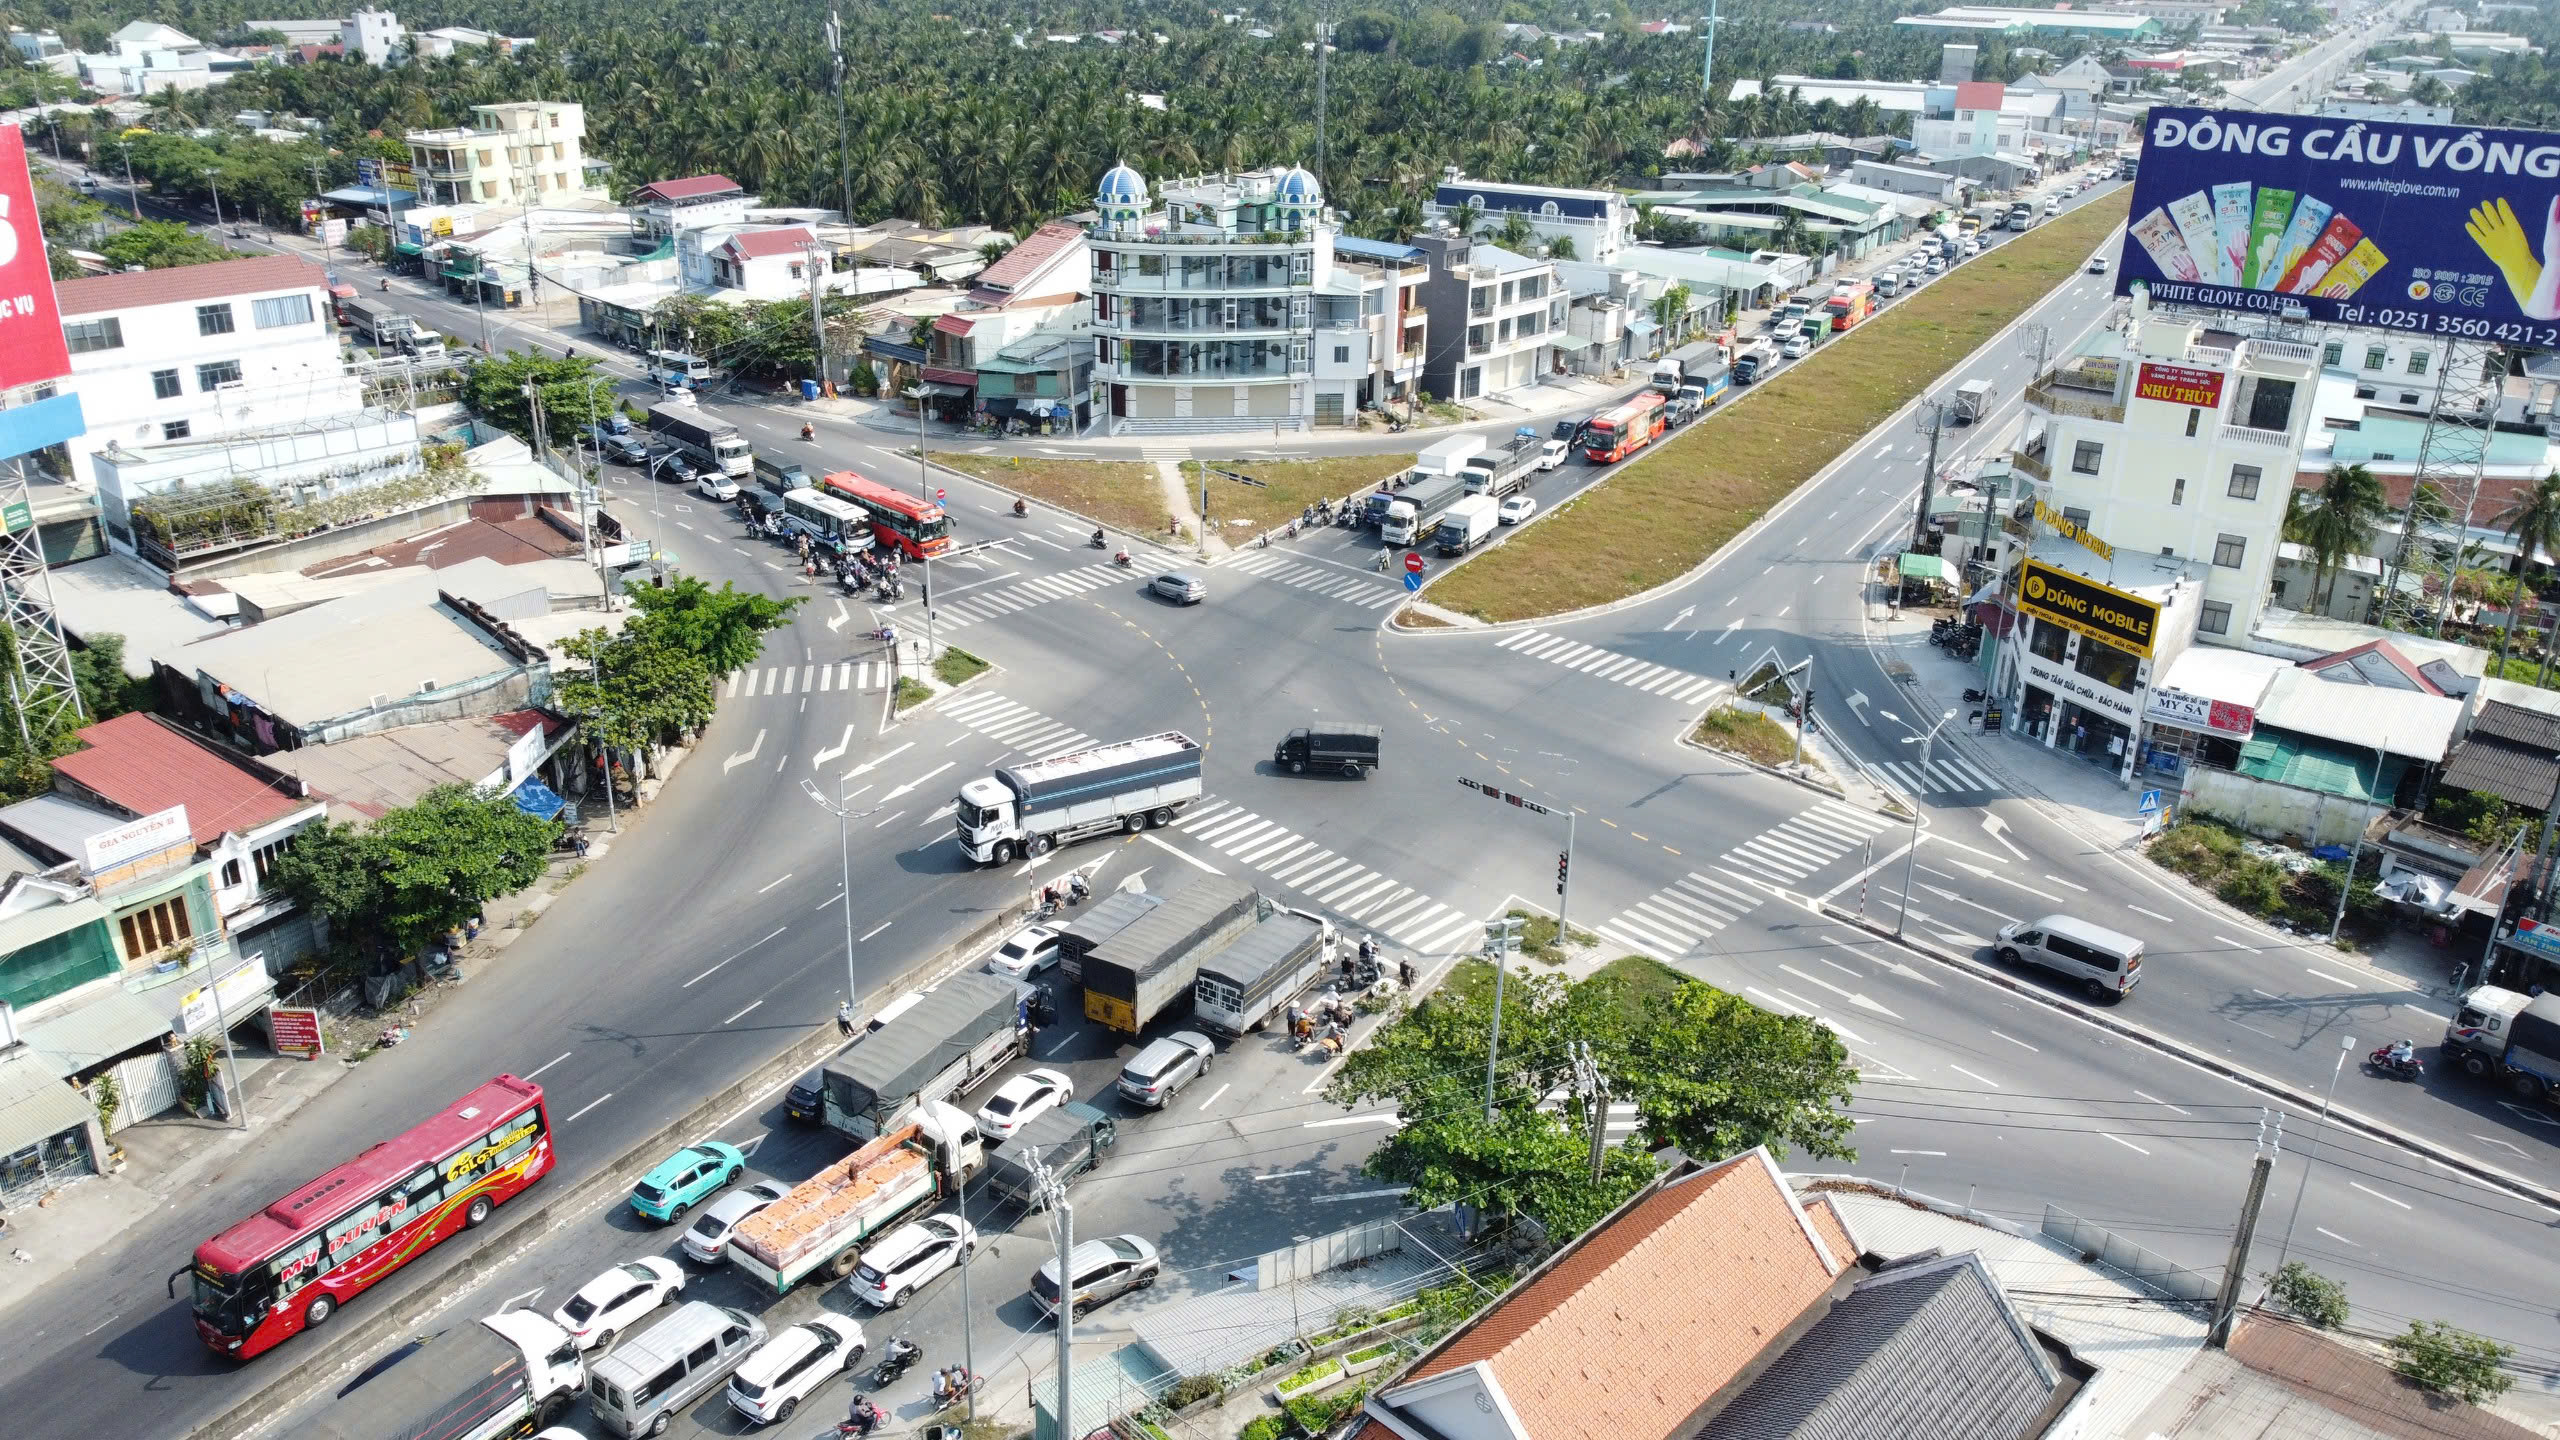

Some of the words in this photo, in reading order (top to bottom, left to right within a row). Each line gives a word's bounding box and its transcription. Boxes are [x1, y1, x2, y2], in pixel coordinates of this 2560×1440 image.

[2153, 115, 2292, 156] ĐÔNG
[2301, 122, 2403, 165] CẦU
[2413, 131, 2560, 178] VỒNG
[2340, 177, 2460, 199] www.whiteglove.com.vn
[2412, 267, 2432, 279] ISO
[2434, 270, 2459, 283] 9001
[2466, 273, 2494, 286] 2015
[2151, 282, 2195, 301] WHITE
[2198, 288, 2244, 307] GLOVE
[2337, 303, 2365, 323] Tel
[2379, 308, 2429, 330] 0251
[2436, 315, 2490, 337] 3560
[2493, 322, 2558, 346] 421-2
[2141, 383, 2175, 399] NHƯ
[2175, 385, 2216, 405] THỦY
[2075, 526, 2113, 563] MOBILE
[2046, 588, 2087, 614] DŨNG
[2091, 604, 2149, 637] MOBILE
[2030, 666, 2050, 680] TRUNG
[2050, 672, 2063, 687] TÂM
[2098, 694, 2112, 707] BẢO
[2113, 700, 2133, 716] HÀNH
[2184, 703, 2203, 716] SA
[99, 837, 119, 850] GIA
[328, 1196, 408, 1255] DUYÊN
